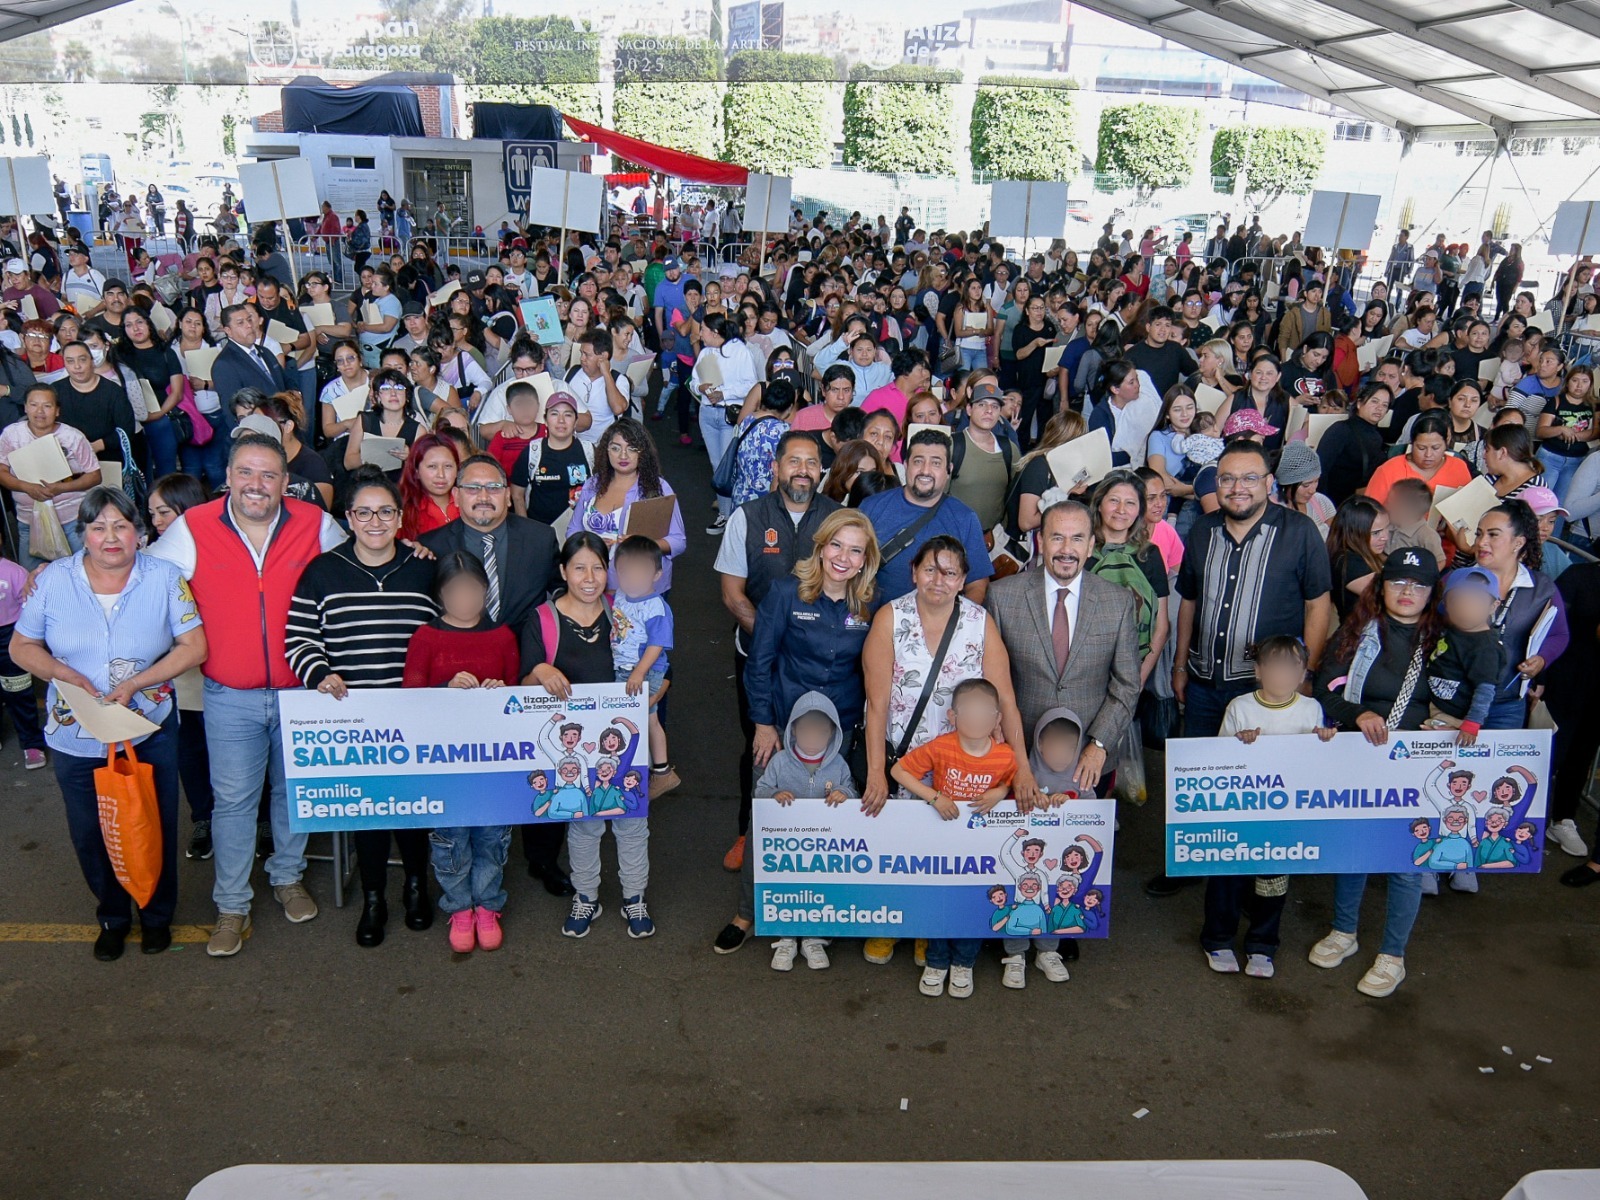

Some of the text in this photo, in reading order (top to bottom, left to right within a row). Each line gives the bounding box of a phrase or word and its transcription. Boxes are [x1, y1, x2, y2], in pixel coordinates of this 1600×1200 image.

[515, 40, 574, 51] FESTIVAL
[577, 39, 681, 51] INTNACIONAL
[685, 40, 705, 50] DE
[732, 38, 769, 50] ARTES
[615, 57, 664, 72] 2025
[567, 701, 597, 711] Social
[601, 701, 641, 709] Creciendo
[292, 728, 404, 745] PROGRAMA
[293, 739, 536, 767] SALARIO FAMILIAR
[1458, 748, 1491, 758] Social
[947, 767, 992, 784] ISLAND
[1175, 774, 1285, 791] PROGRAMA
[295, 784, 362, 799] Familia
[298, 796, 444, 818] Beneficiada
[1175, 787, 1420, 813] SALARIO FAMILIAR
[1031, 817, 1060, 826] Social
[1174, 830, 1239, 843] Familia
[762, 837, 869, 852] PROGRAMA
[1175, 842, 1320, 862] Beneficiada
[762, 853, 996, 875] SALARIO FAMILIAR
[762, 890, 825, 904] Familia
[763, 904, 903, 924] Beneficiada
